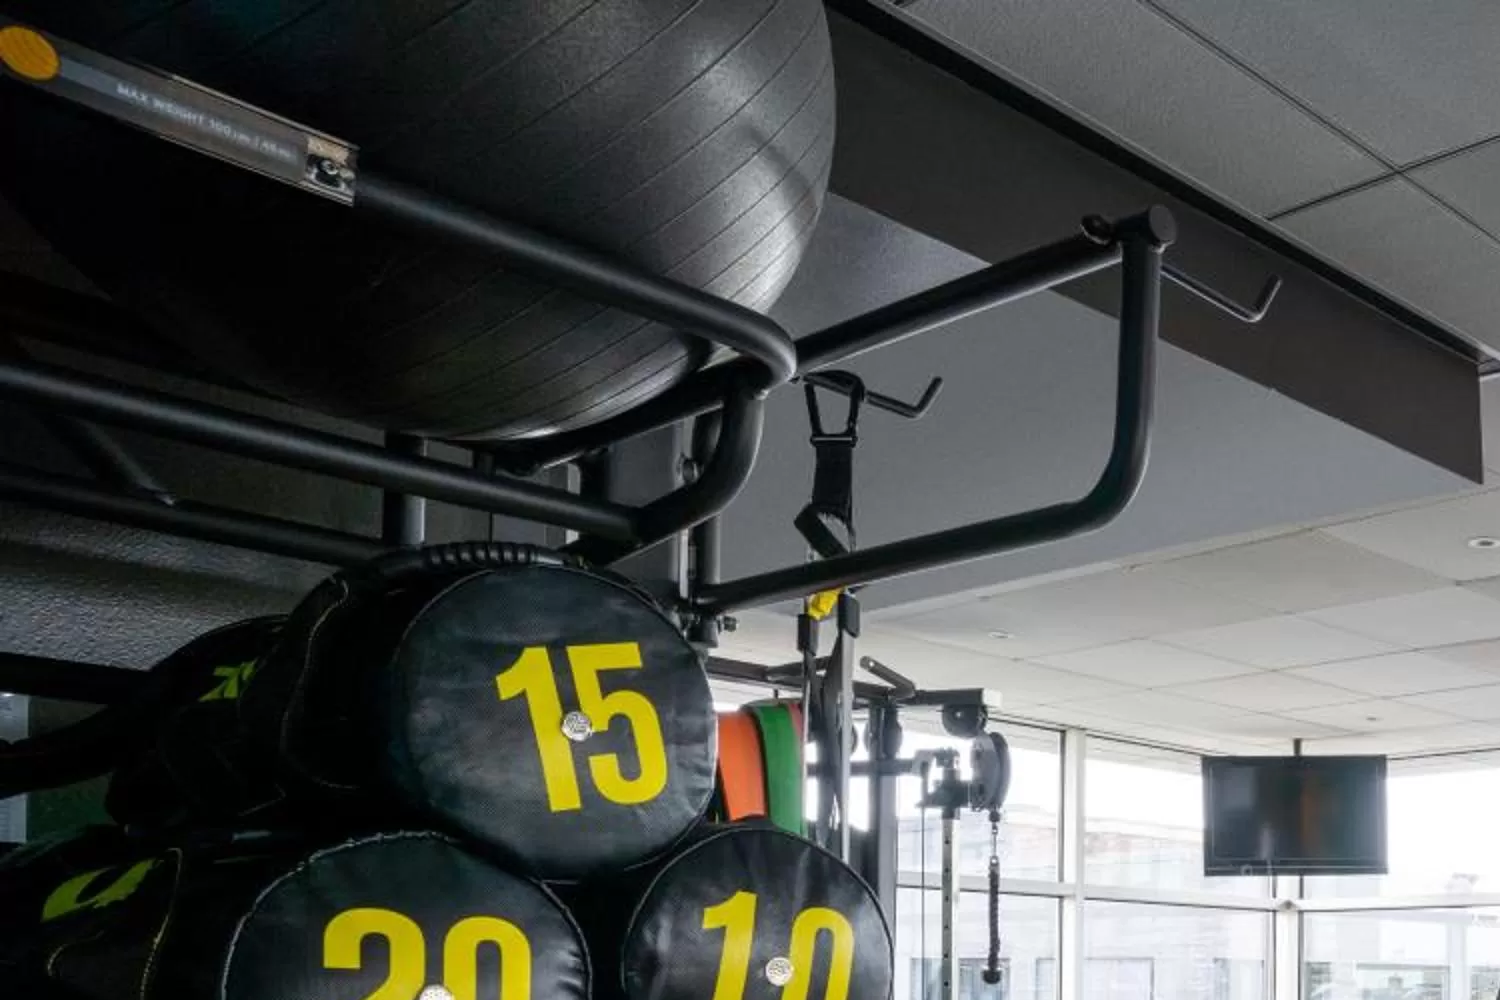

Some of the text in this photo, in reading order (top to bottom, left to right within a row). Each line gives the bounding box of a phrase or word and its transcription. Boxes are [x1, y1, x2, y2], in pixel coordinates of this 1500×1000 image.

[116, 82, 149, 103] MAX
[152, 99, 205, 125] WEIGHT
[496, 642, 668, 812] 15
